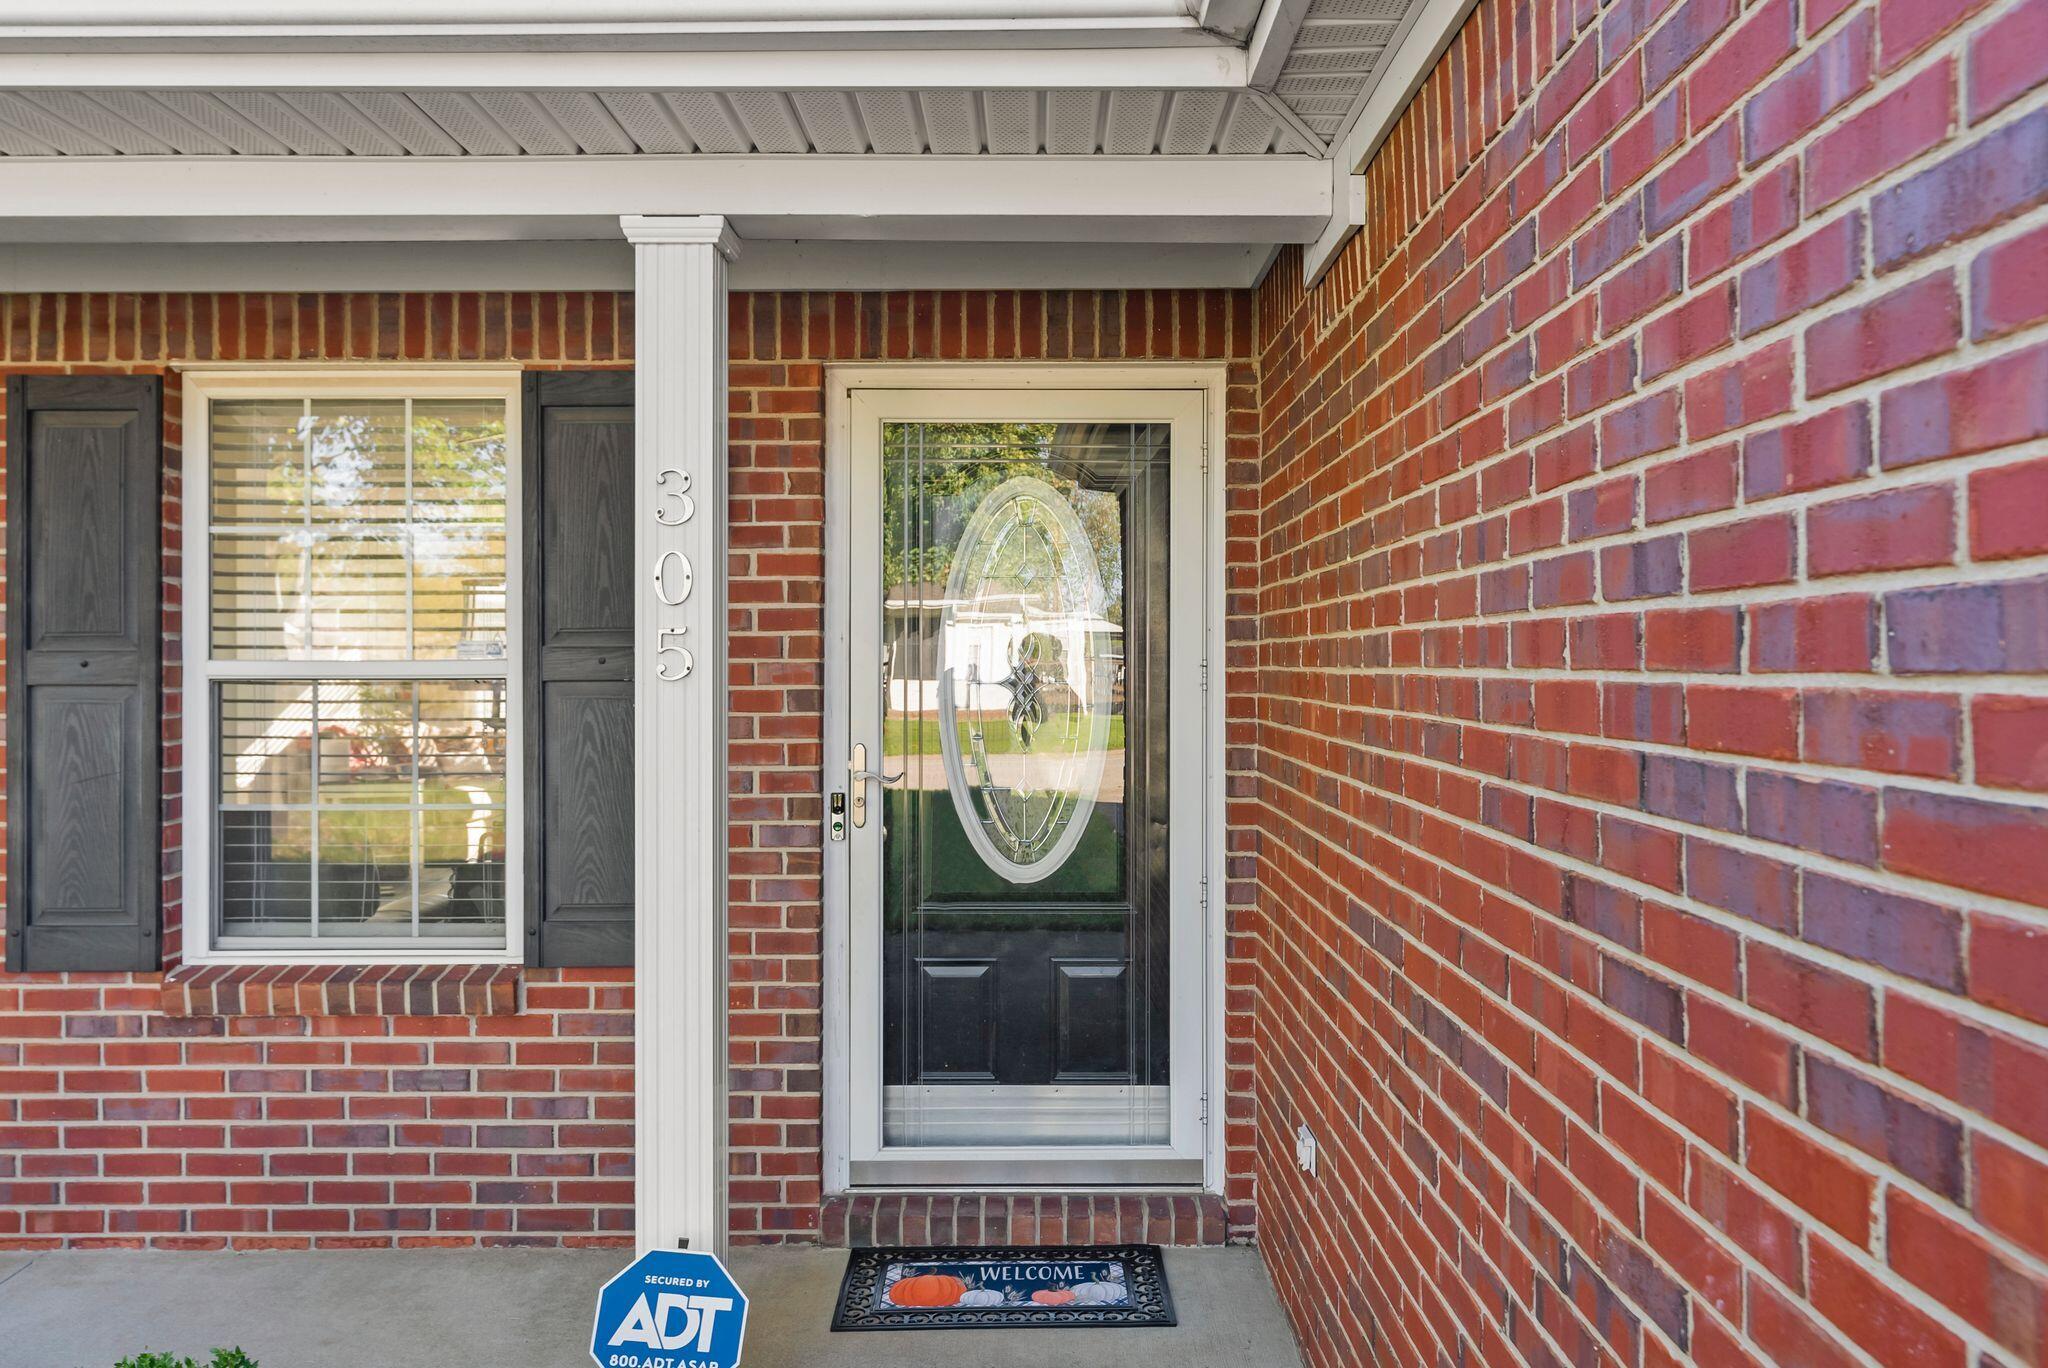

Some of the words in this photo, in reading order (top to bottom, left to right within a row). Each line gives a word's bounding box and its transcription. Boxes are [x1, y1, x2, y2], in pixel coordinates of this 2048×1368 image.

[654, 468, 695, 681] 305
[644, 1274, 694, 1287] SECURED
[696, 1279, 710, 1288] BY
[980, 1265, 1085, 1281] WELCOME
[607, 1291, 733, 1353] ADT
[609, 1354, 719, 1368] 800.ADTASAP
